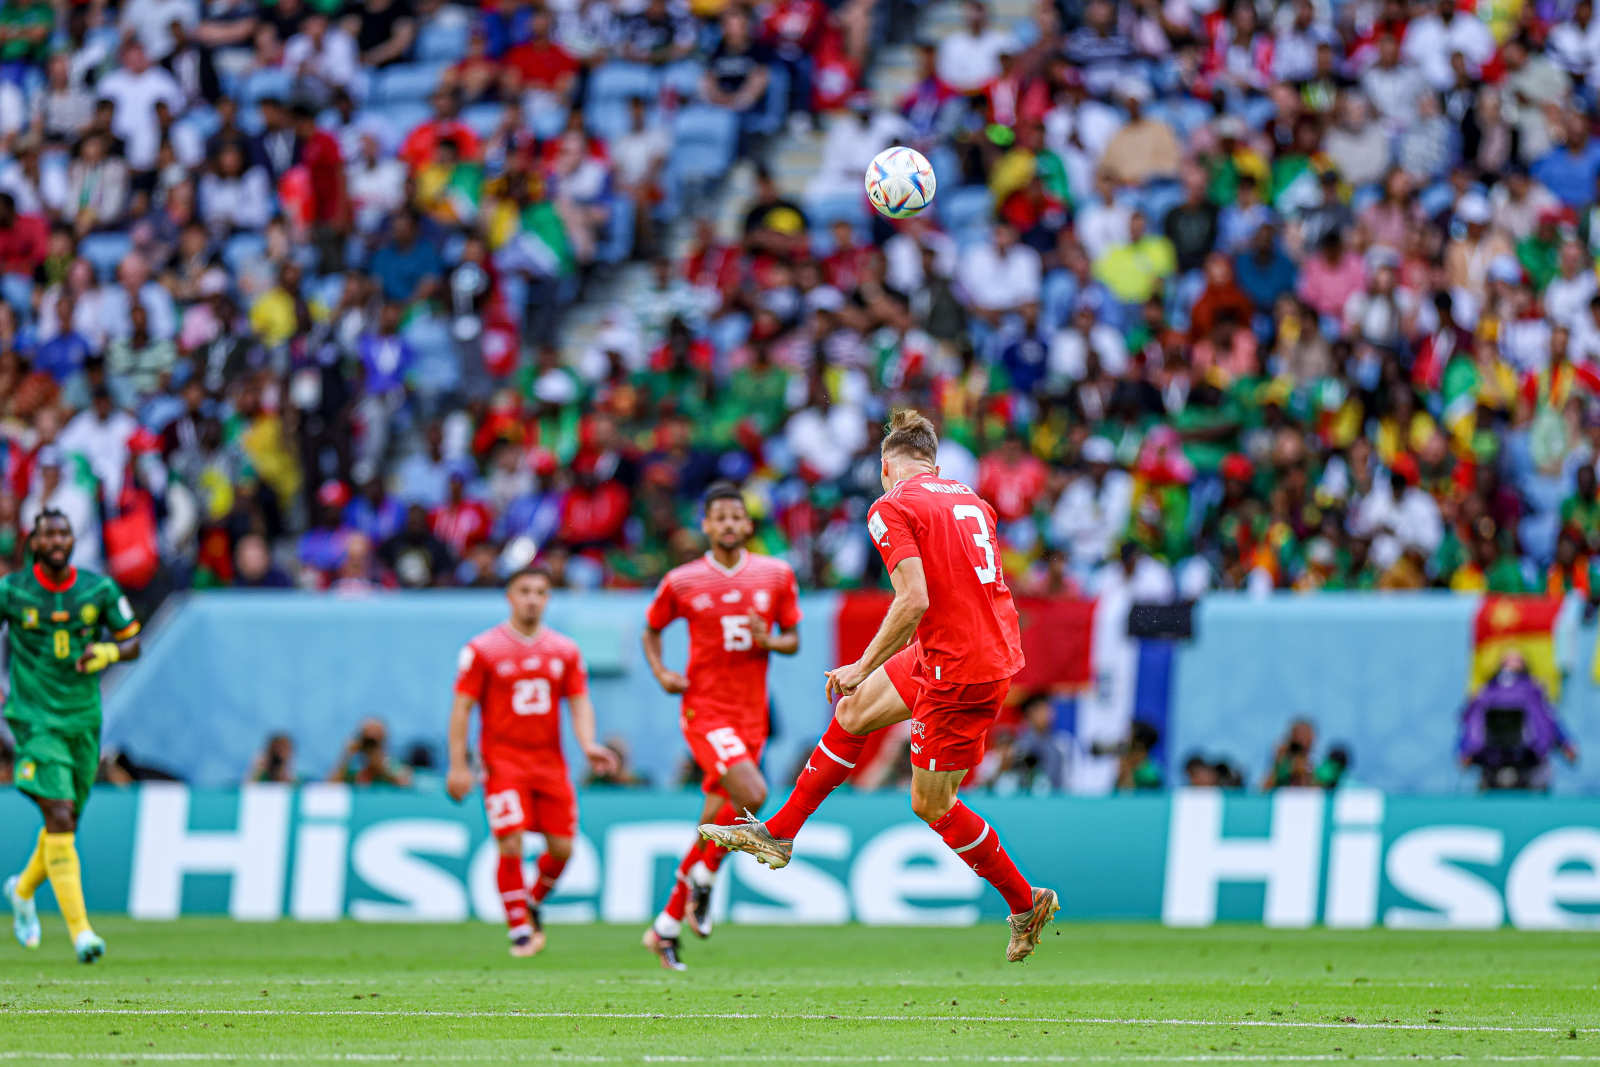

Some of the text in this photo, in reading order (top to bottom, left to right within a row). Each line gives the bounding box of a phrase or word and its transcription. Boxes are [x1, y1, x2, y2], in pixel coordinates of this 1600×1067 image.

[952, 504, 996, 584] 3
[721, 614, 752, 651] 15
[512, 678, 551, 715] 23
[706, 727, 746, 761] 15
[487, 789, 525, 829] 23
[128, 781, 984, 925] Hisense
